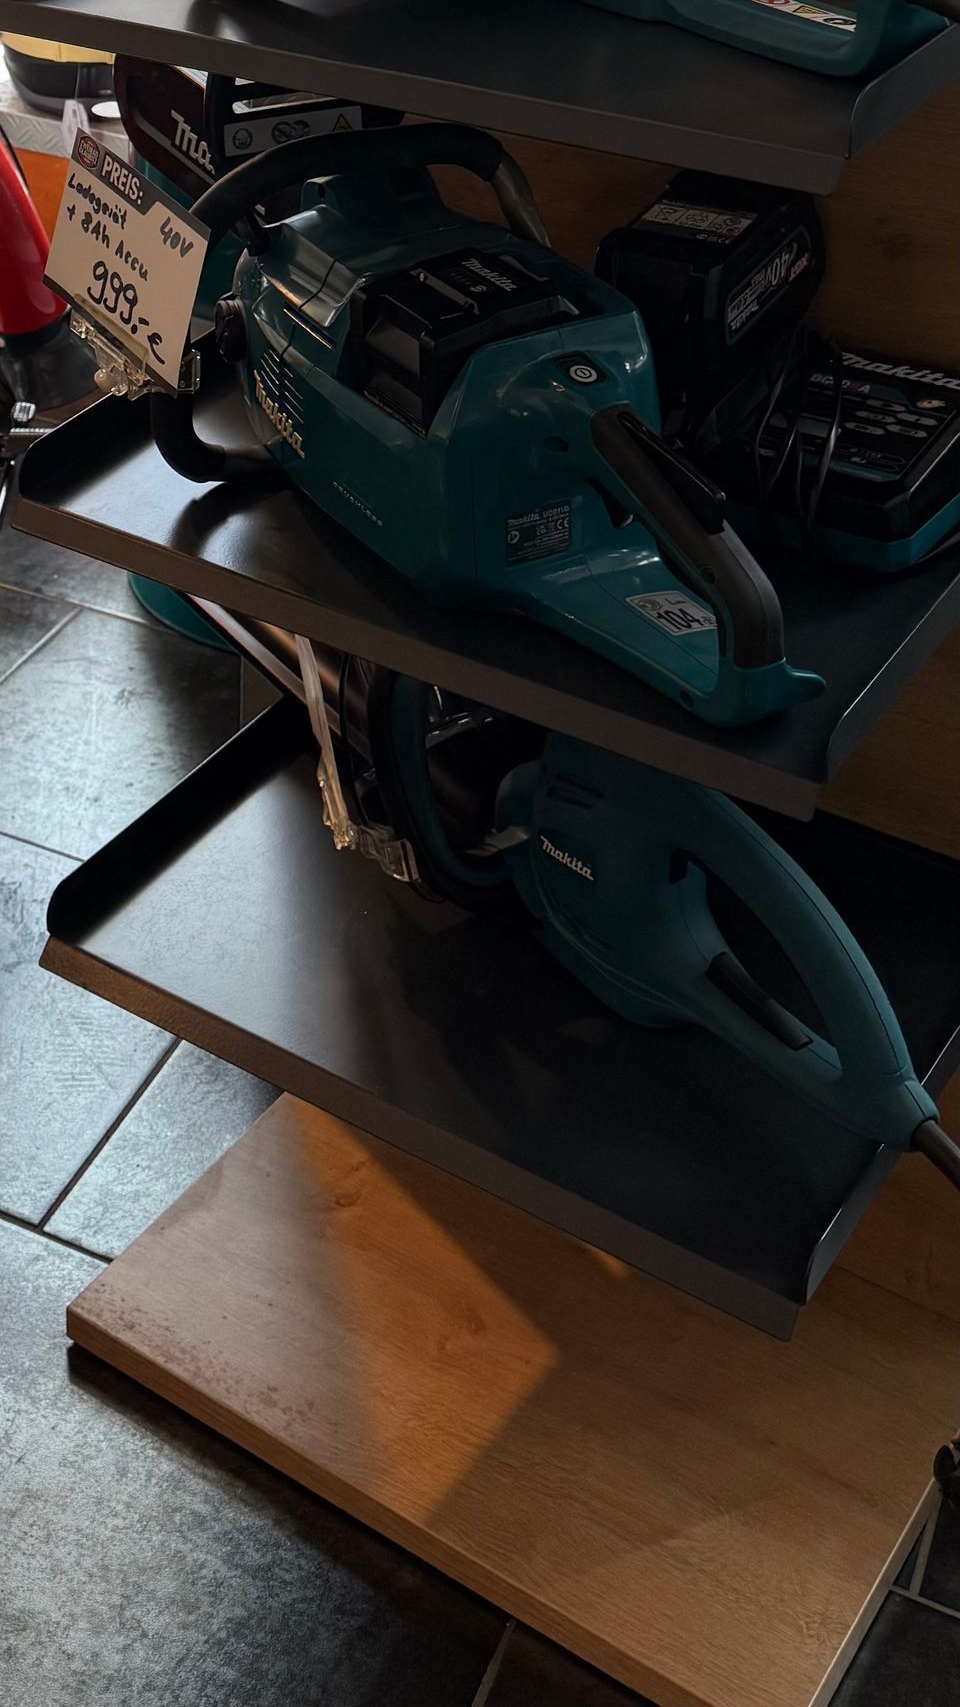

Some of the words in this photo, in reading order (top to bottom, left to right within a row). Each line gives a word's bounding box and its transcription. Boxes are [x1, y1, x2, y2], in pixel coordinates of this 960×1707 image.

[102, 154, 144, 206] PREIS:
[160, 216, 195, 259] 40V
[537, 835, 596, 883] makita
